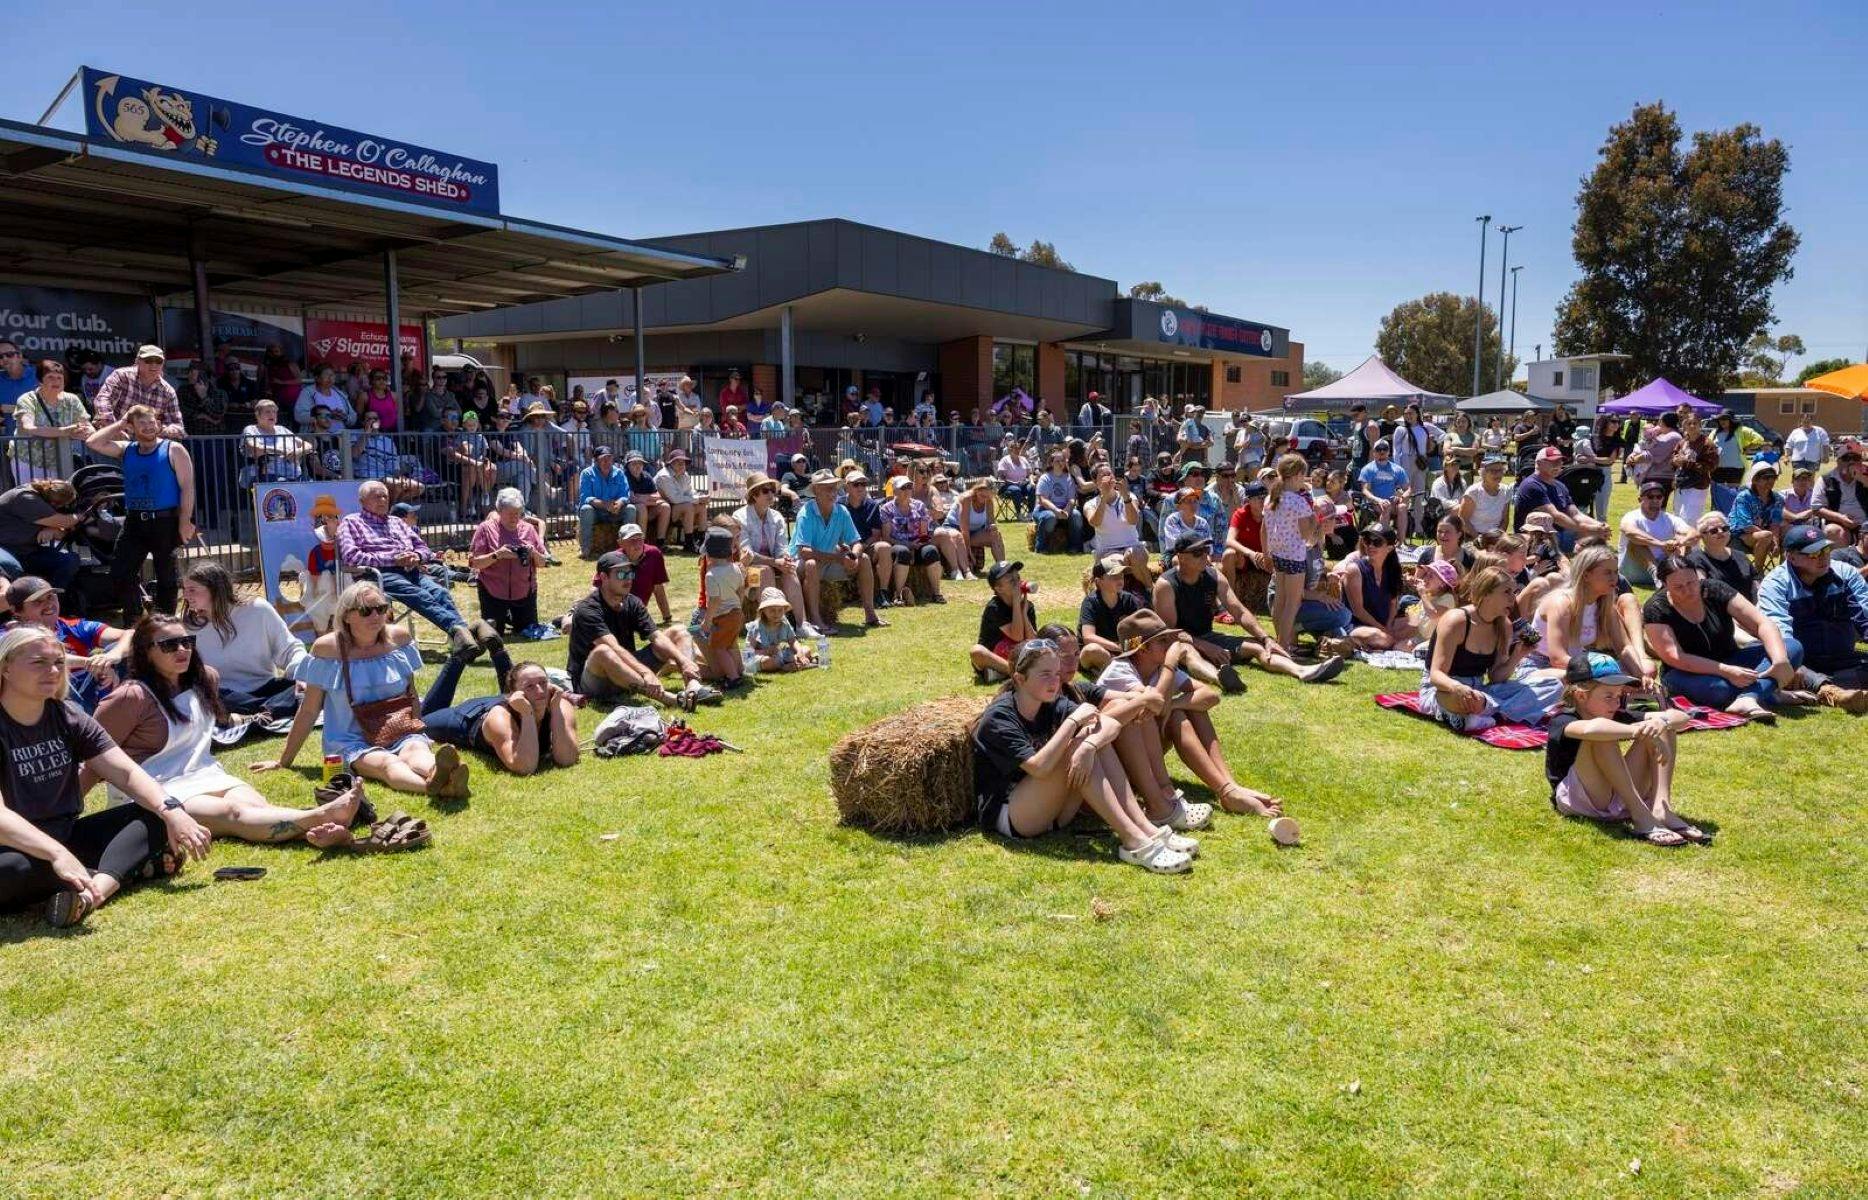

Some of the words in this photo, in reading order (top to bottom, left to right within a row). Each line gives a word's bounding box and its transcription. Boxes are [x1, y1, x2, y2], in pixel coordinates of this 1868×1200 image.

[123, 103, 145, 115] 565
[240, 118, 352, 156] Stephen
[356, 139, 488, 186] O'Callaghan
[281, 149, 323, 171] THE
[327, 161, 412, 188] LEGENDS
[415, 178, 460, 198] SHED
[56, 312, 112, 333] Club.
[12, 736, 65, 762] RIDERS
[18, 760, 36, 777] BY
[38, 751, 72, 772] LEE
